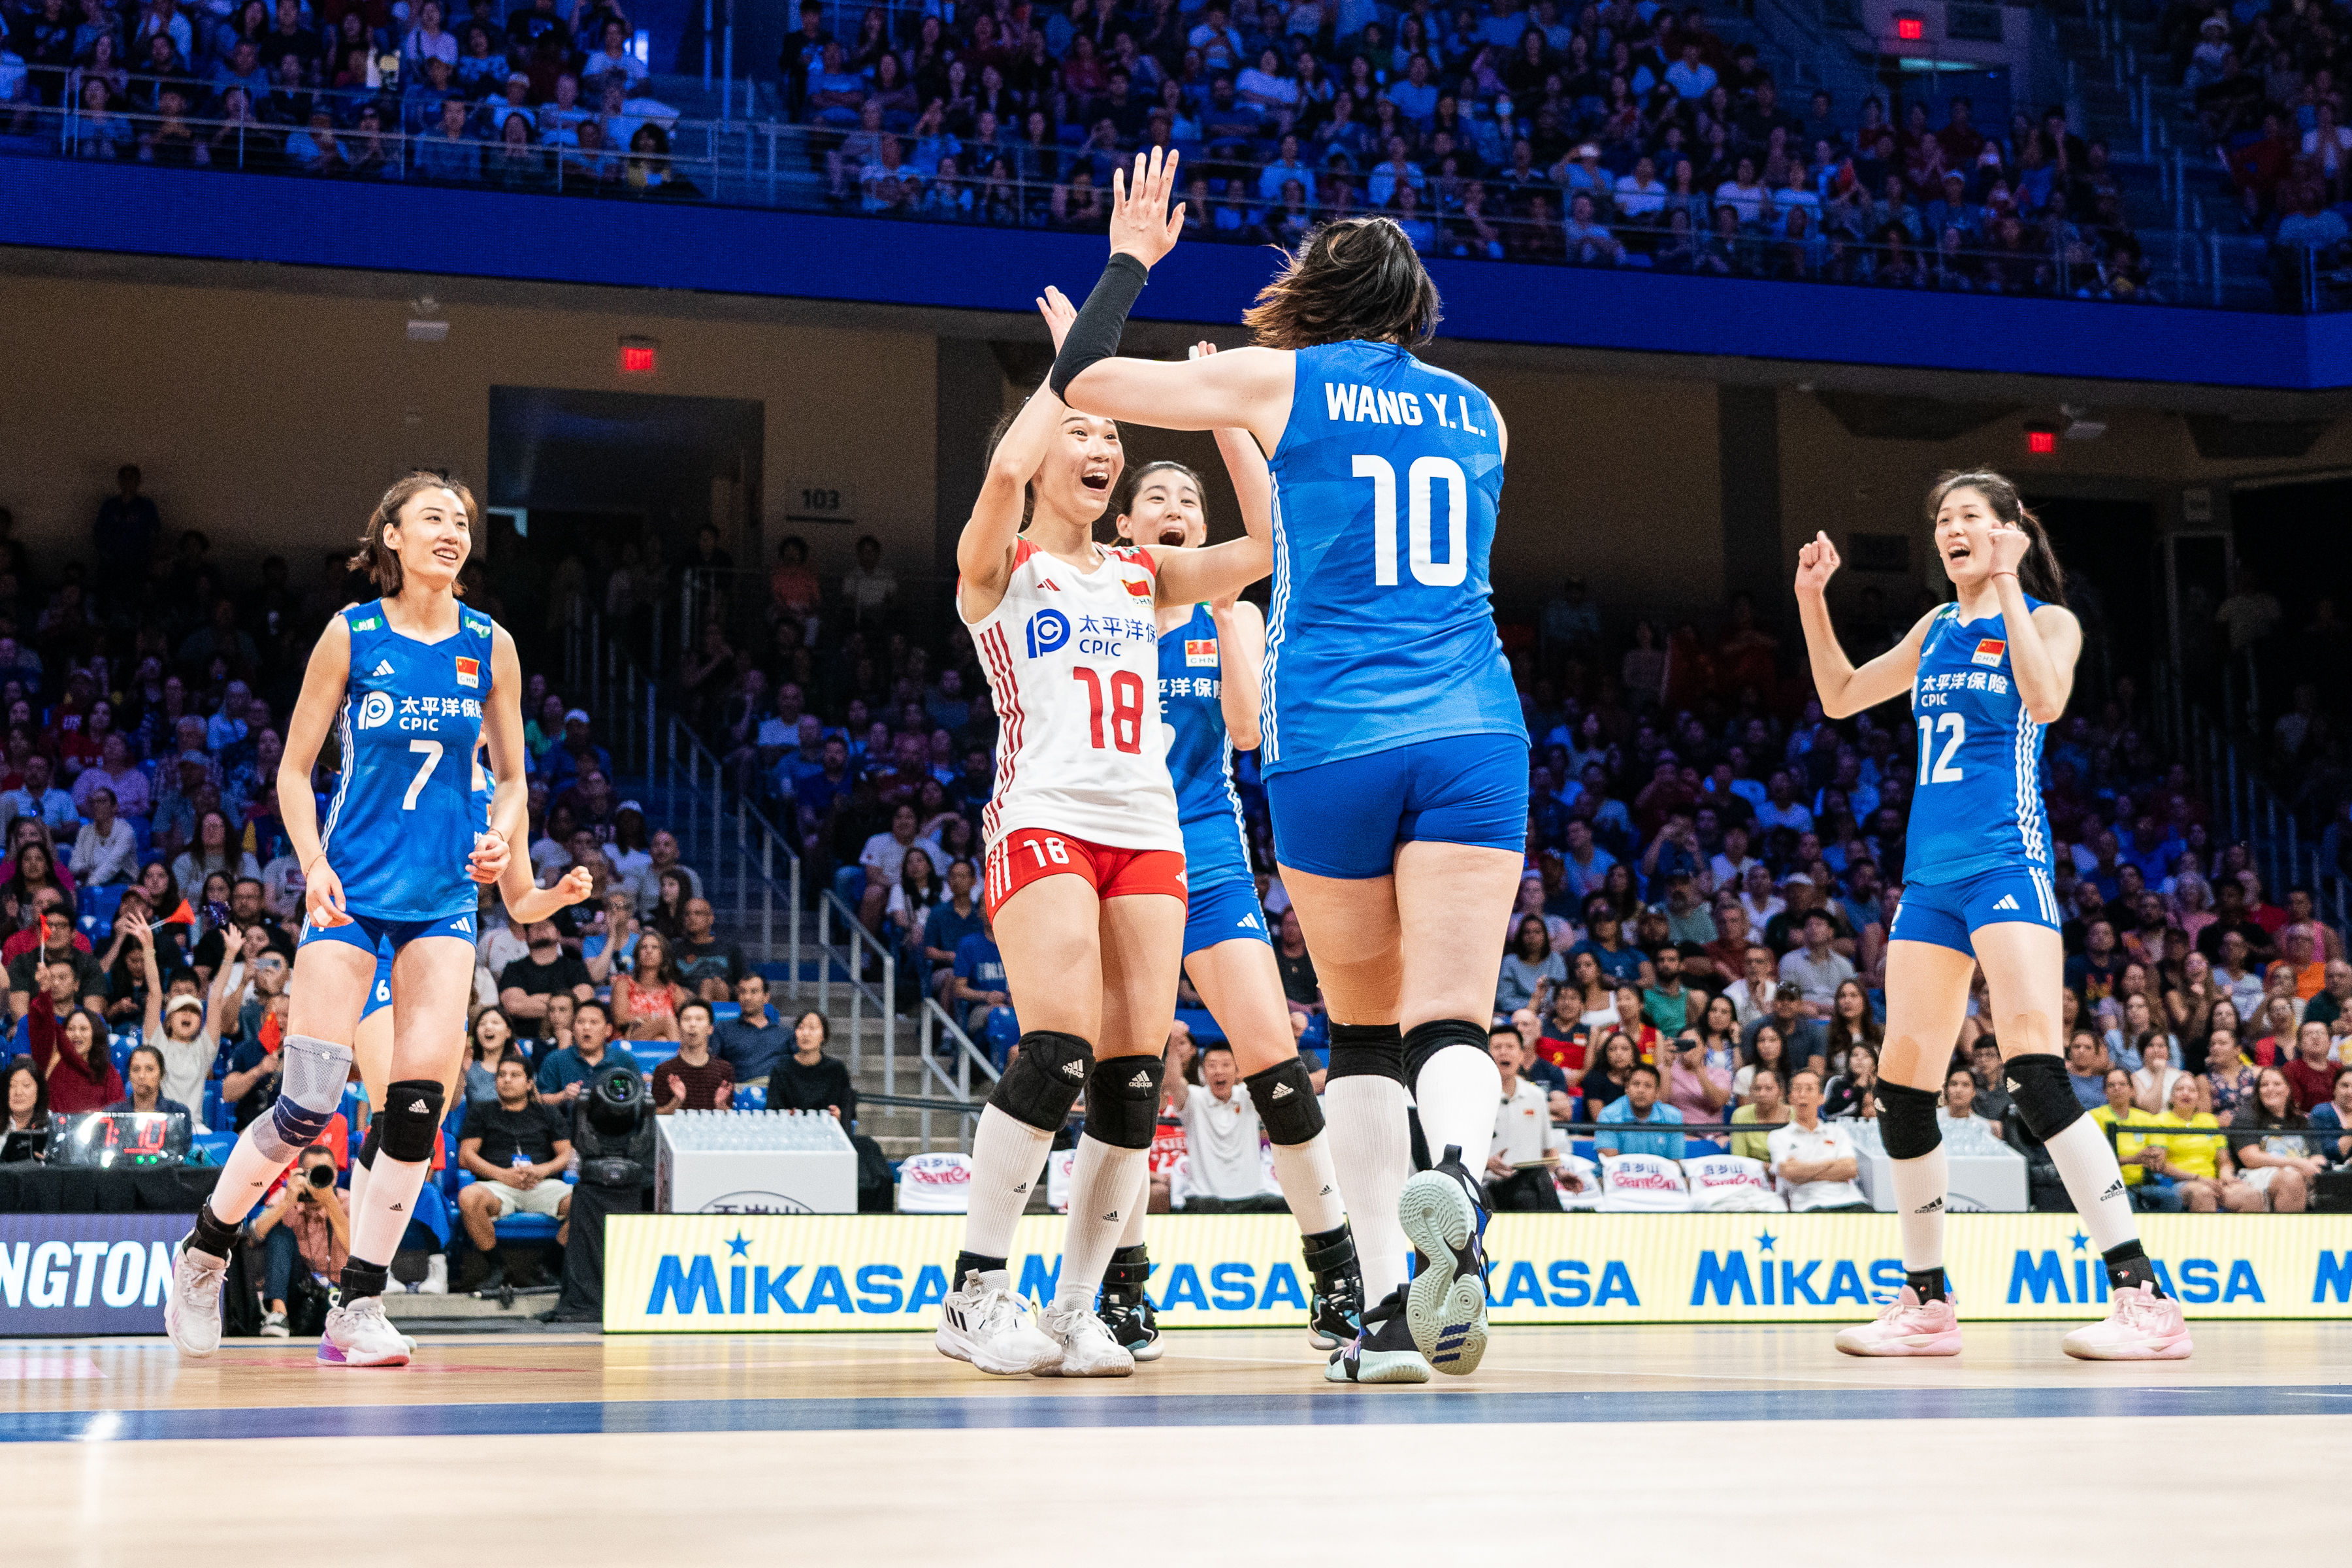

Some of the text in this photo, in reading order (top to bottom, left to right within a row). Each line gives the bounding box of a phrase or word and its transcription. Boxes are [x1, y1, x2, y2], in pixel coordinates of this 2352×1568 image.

[1325, 382, 1424, 426] WANG
[802, 488, 840, 510] 103
[1351, 454, 1467, 587] 10
[1079, 614, 1158, 647] 太平洋保
[1079, 638, 1122, 657] CPIC
[1976, 655, 1997, 663] CHN
[459, 674, 477, 685] CHN
[1158, 677, 1221, 699] 平洋保
[1920, 672, 2008, 694] 太平洋保险
[1073, 666, 1144, 755] 18
[1921, 693, 1948, 708] CPIC
[399, 717, 439, 731] CPIC
[1919, 712, 1965, 785] 12
[402, 739, 444, 810] 7
[1023, 837, 1070, 868] 18
[376, 979, 390, 1002] 6
[1914, 1203, 1944, 1214] adida
